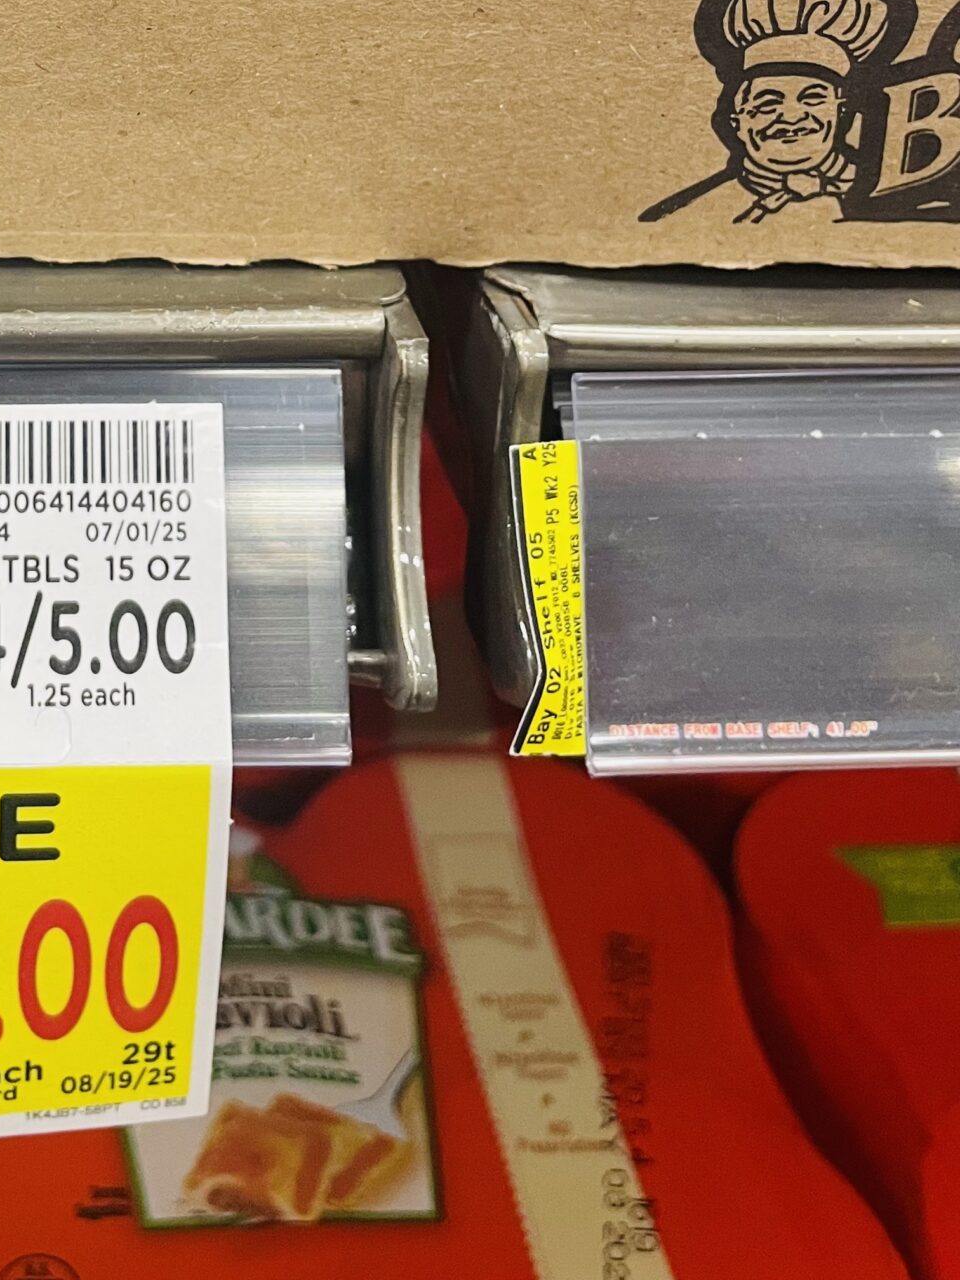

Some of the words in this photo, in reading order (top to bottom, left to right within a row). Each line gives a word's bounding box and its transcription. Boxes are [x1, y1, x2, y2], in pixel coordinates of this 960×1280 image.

[523, 447, 537, 462] A
[542, 442, 557, 467] Y25
[543, 475, 558, 501] Wk2
[546, 508, 560, 525] P5
[86, 522, 187, 544] 07/01/25
[529, 531, 544, 559] 05
[105, 555, 134, 581] 15
[146, 555, 192, 581] OZ
[570, 533, 581, 584] SHELVES
[536, 579, 557, 650] Shelf
[573, 614, 583, 678] MICROWAVE
[546, 667, 562, 693] 02
[27, 683, 72, 708] 1.25
[80, 683, 136, 708] each
[528, 708, 558, 745] Bay
[609, 723, 678, 738] DISTANCE
[684, 723, 721, 737] FROM
[726, 722, 763, 737] BASE
[227, 894, 421, 963] ARDEE
[123, 1042, 176, 1066] 29t
[61, 1066, 177, 1095] 08/19/25
